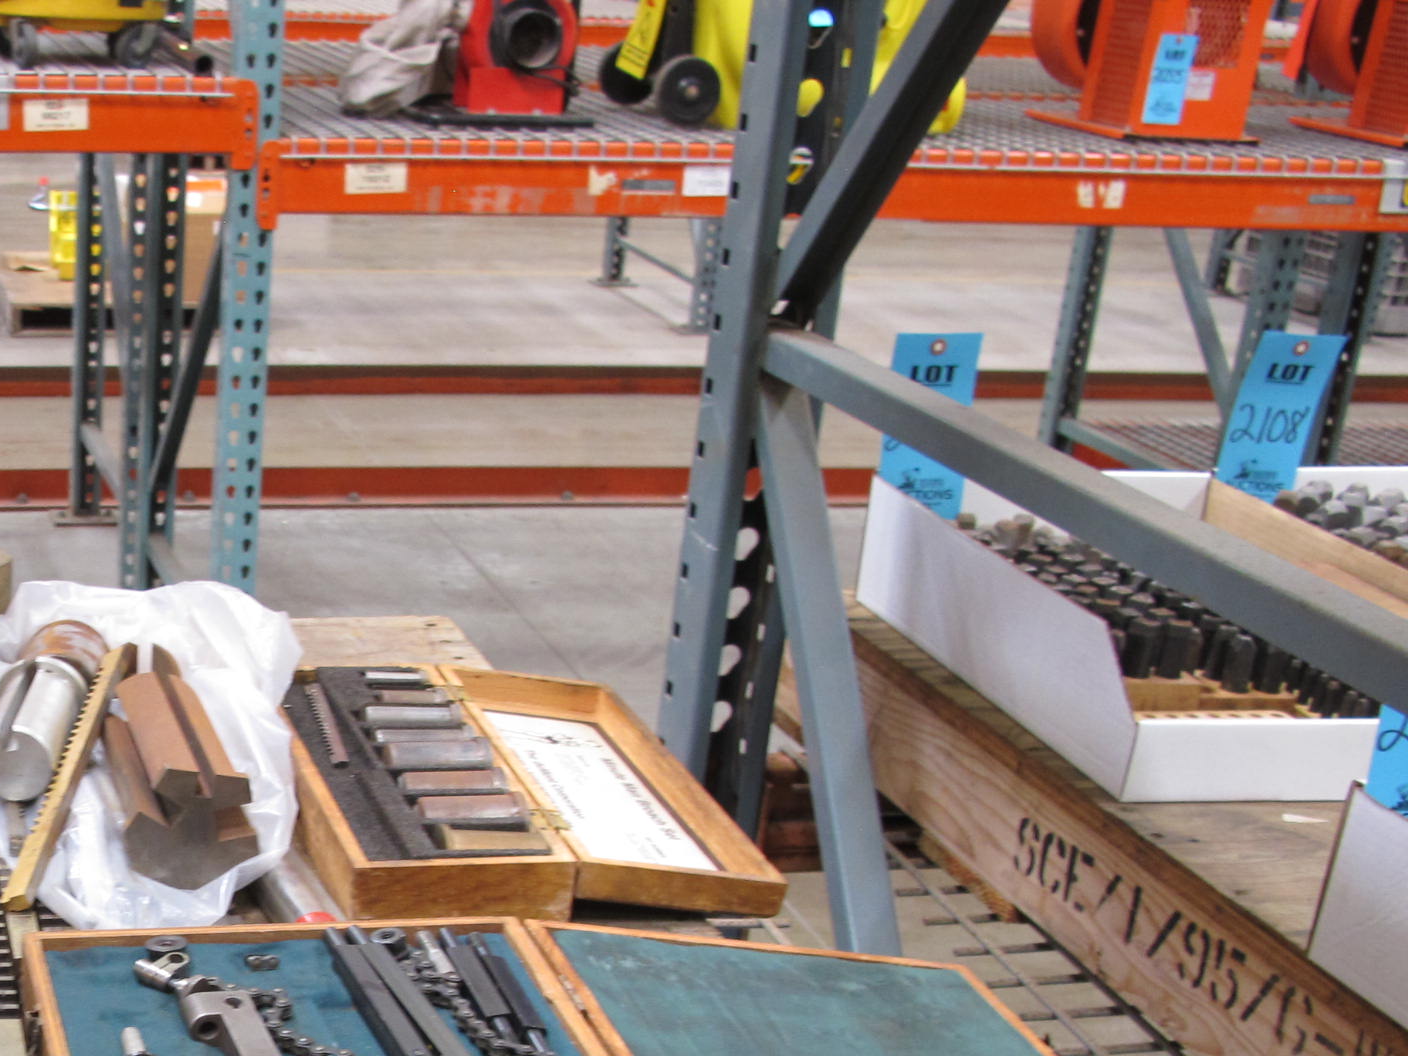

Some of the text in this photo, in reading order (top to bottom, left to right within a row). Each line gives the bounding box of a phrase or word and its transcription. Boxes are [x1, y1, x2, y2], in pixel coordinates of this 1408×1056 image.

[909, 364, 958, 384] LOT
[1267, 363, 1313, 382] LOT
[1228, 403, 1311, 444] 2108
